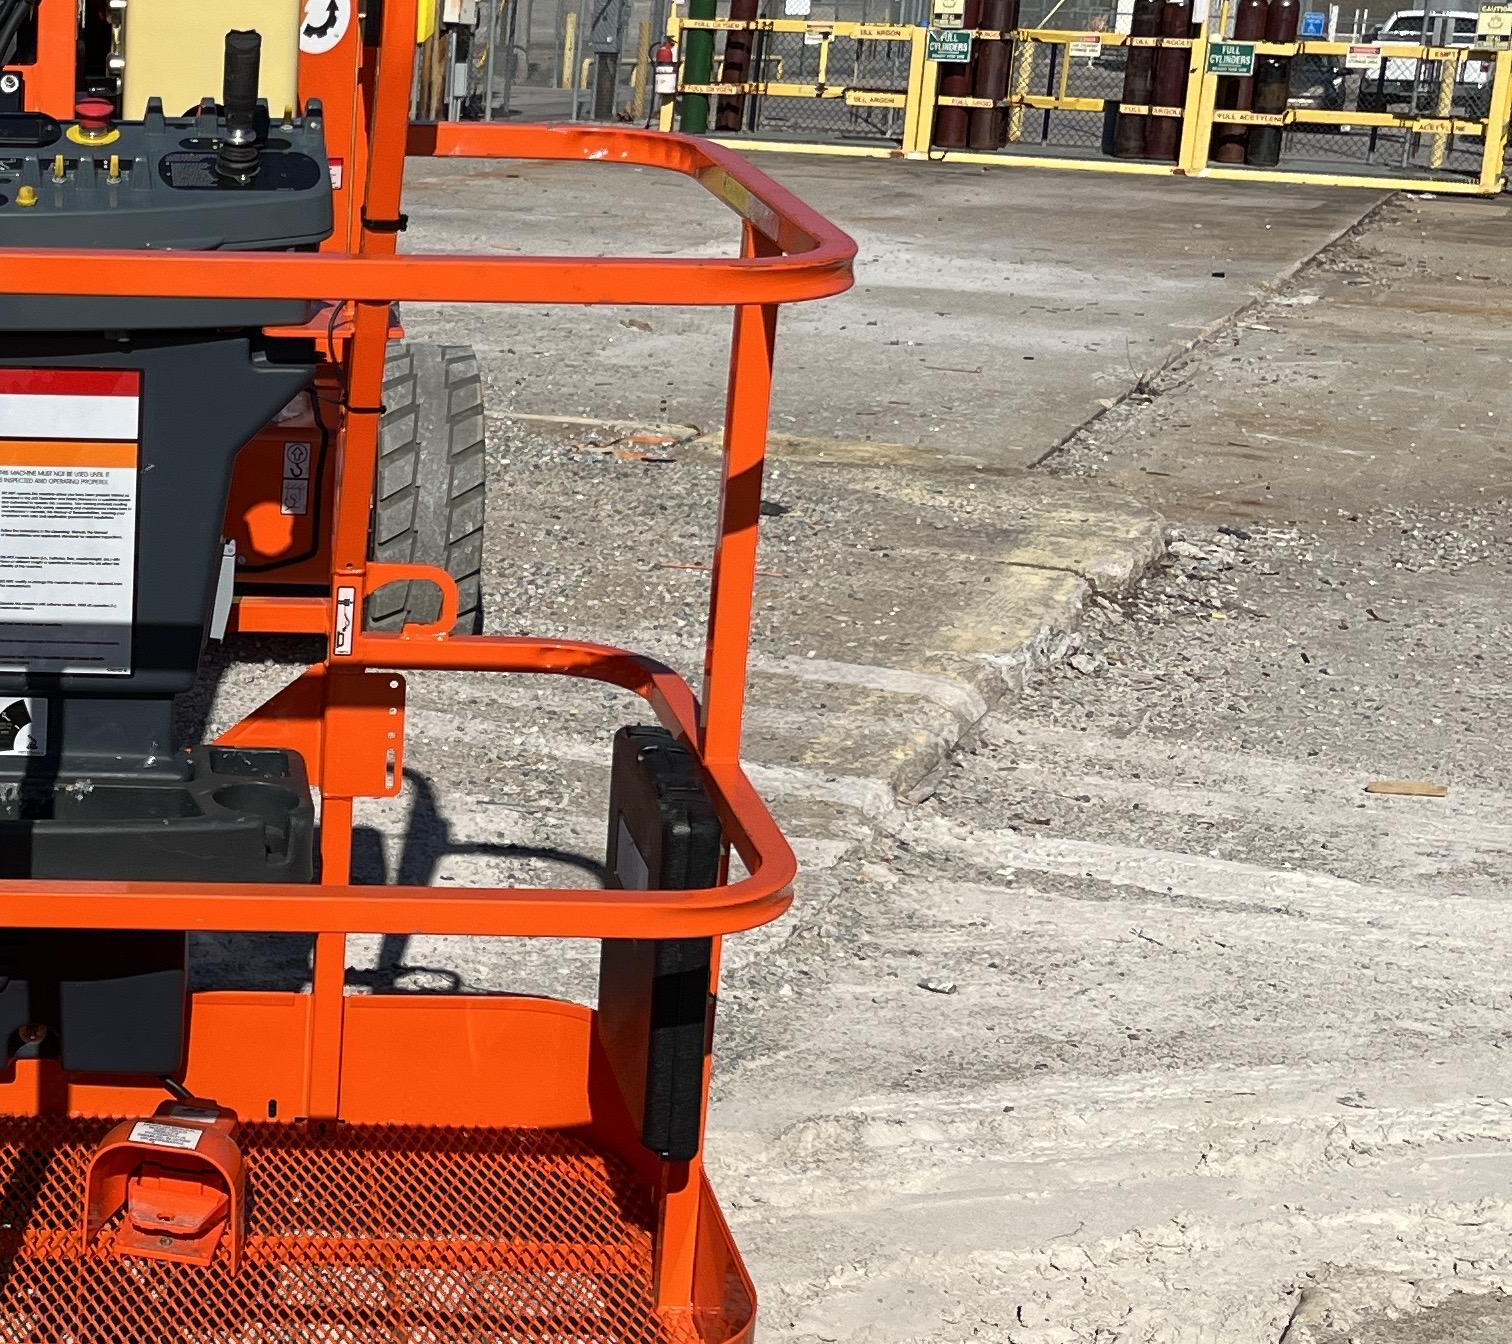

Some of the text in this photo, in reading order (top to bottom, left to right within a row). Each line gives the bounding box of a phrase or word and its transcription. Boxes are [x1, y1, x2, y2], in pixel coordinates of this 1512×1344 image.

[940, 32, 959, 42] FULL
[929, 43, 968, 52] CYLINDERS
[1222, 45, 1241, 55] FULL
[1209, 54, 1251, 65] CYLINDERS
